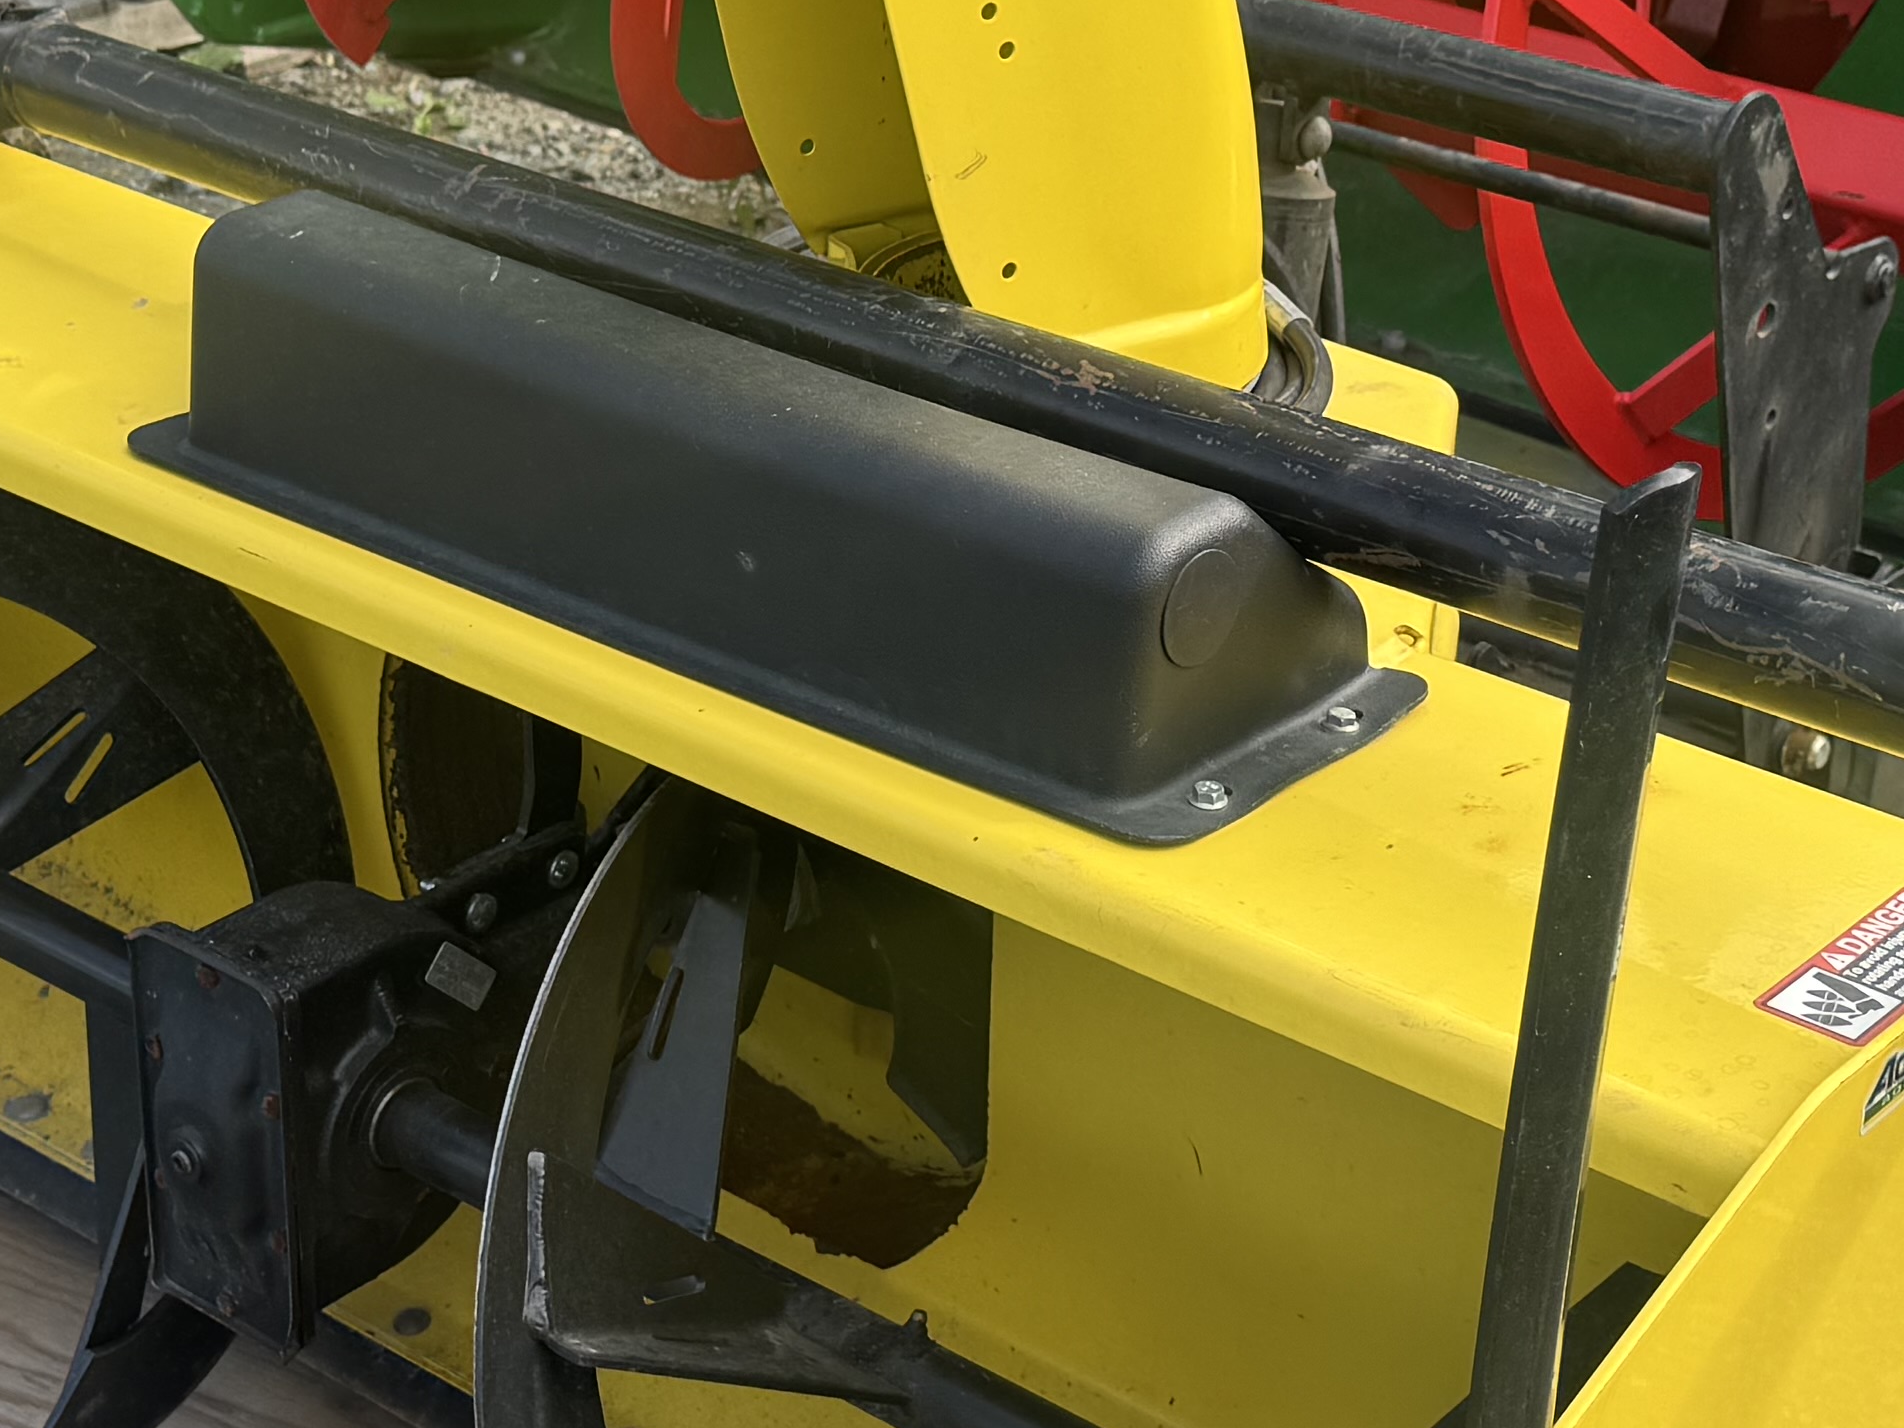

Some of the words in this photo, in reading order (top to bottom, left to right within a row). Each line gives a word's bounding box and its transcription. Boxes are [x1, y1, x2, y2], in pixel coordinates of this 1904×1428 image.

[1843, 967, 1863, 978] To
[1862, 948, 1888, 969] avoid
[1862, 953, 1904, 985] rotating
